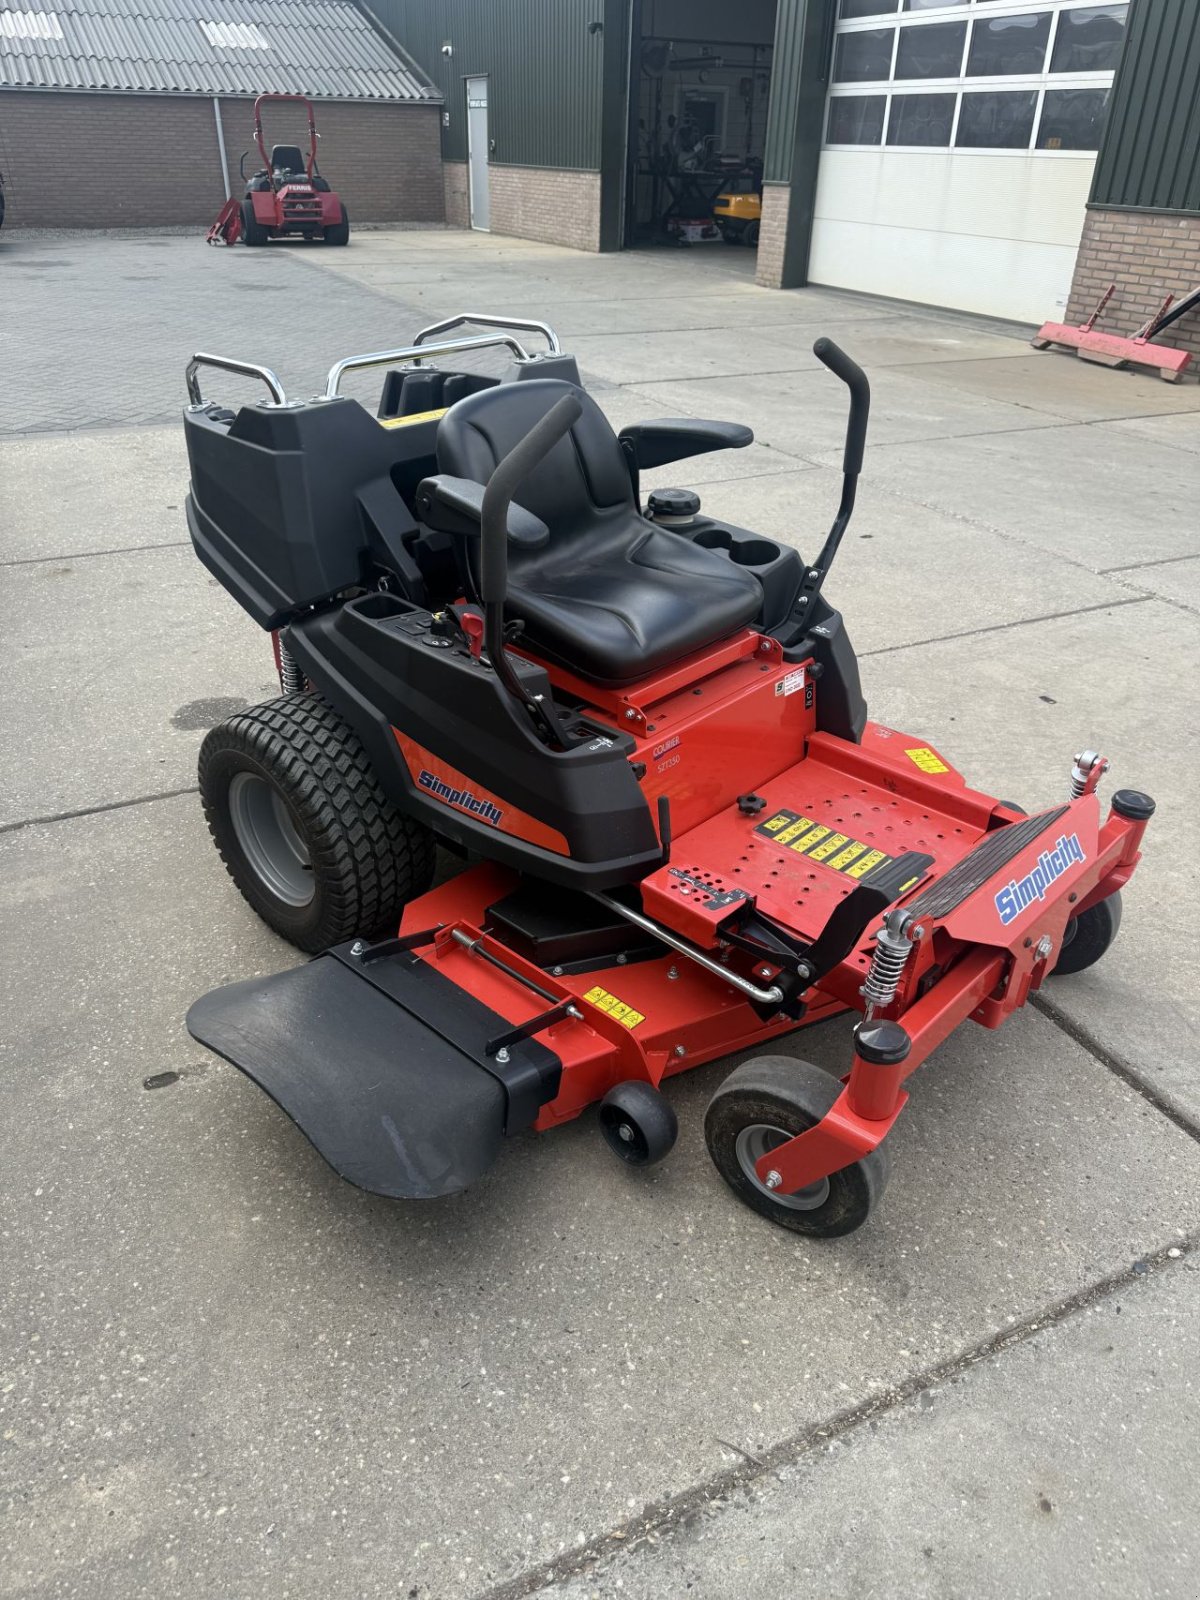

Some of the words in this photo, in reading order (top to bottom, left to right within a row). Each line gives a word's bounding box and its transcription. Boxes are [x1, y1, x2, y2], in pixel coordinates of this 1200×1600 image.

[653, 736, 680, 758] COURIER
[418, 769, 504, 827] Simplicity
[994, 832, 1086, 926] Simplicity
